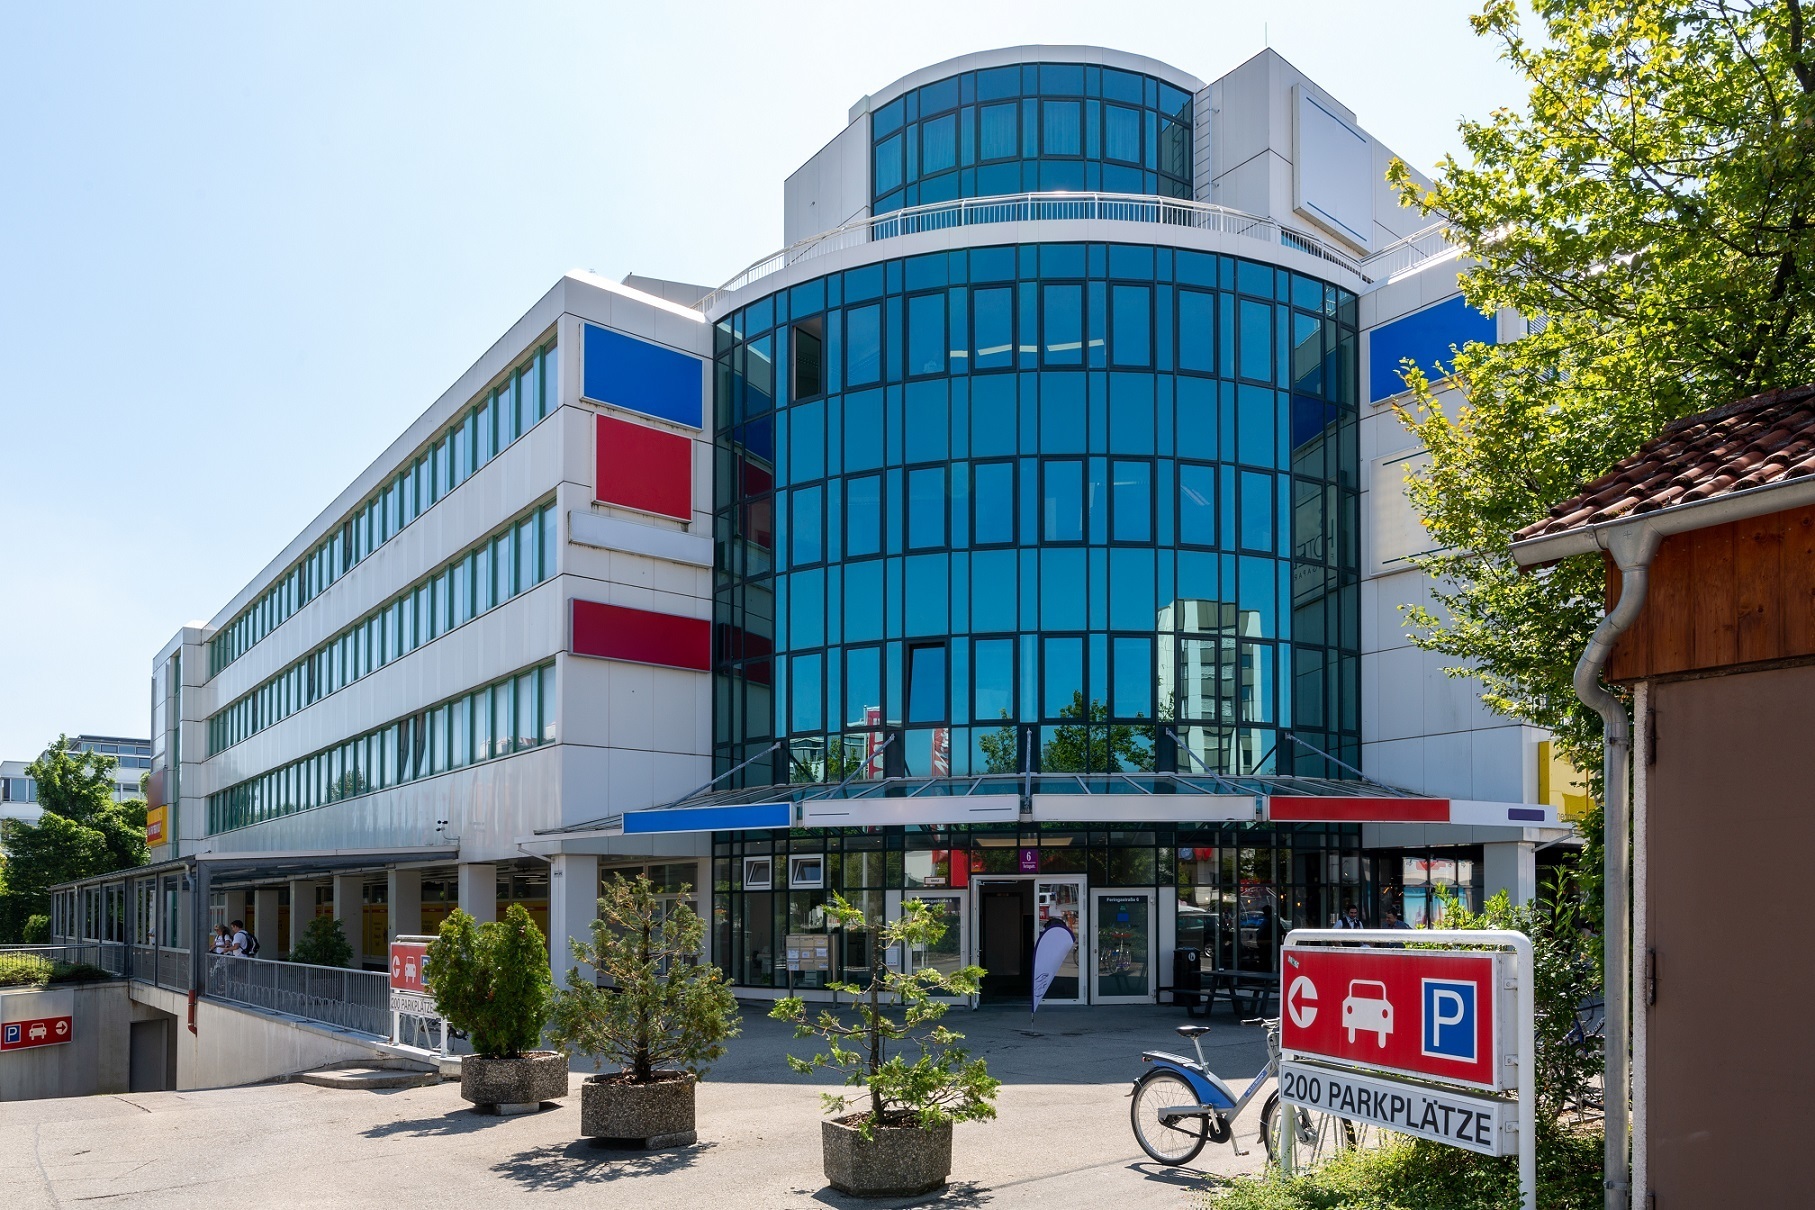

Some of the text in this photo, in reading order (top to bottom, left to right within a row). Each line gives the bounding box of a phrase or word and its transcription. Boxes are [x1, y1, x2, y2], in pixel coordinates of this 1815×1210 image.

[1026, 851, 1032, 862] 6
[391, 997, 434, 1015] 200 PARKPLÄTZE
[1433, 989, 1465, 1047] P
[7, 1026, 18, 1042] P
[1283, 1071, 1322, 1104] 200
[1328, 1081, 1491, 1146] PARKPLÄTZE
